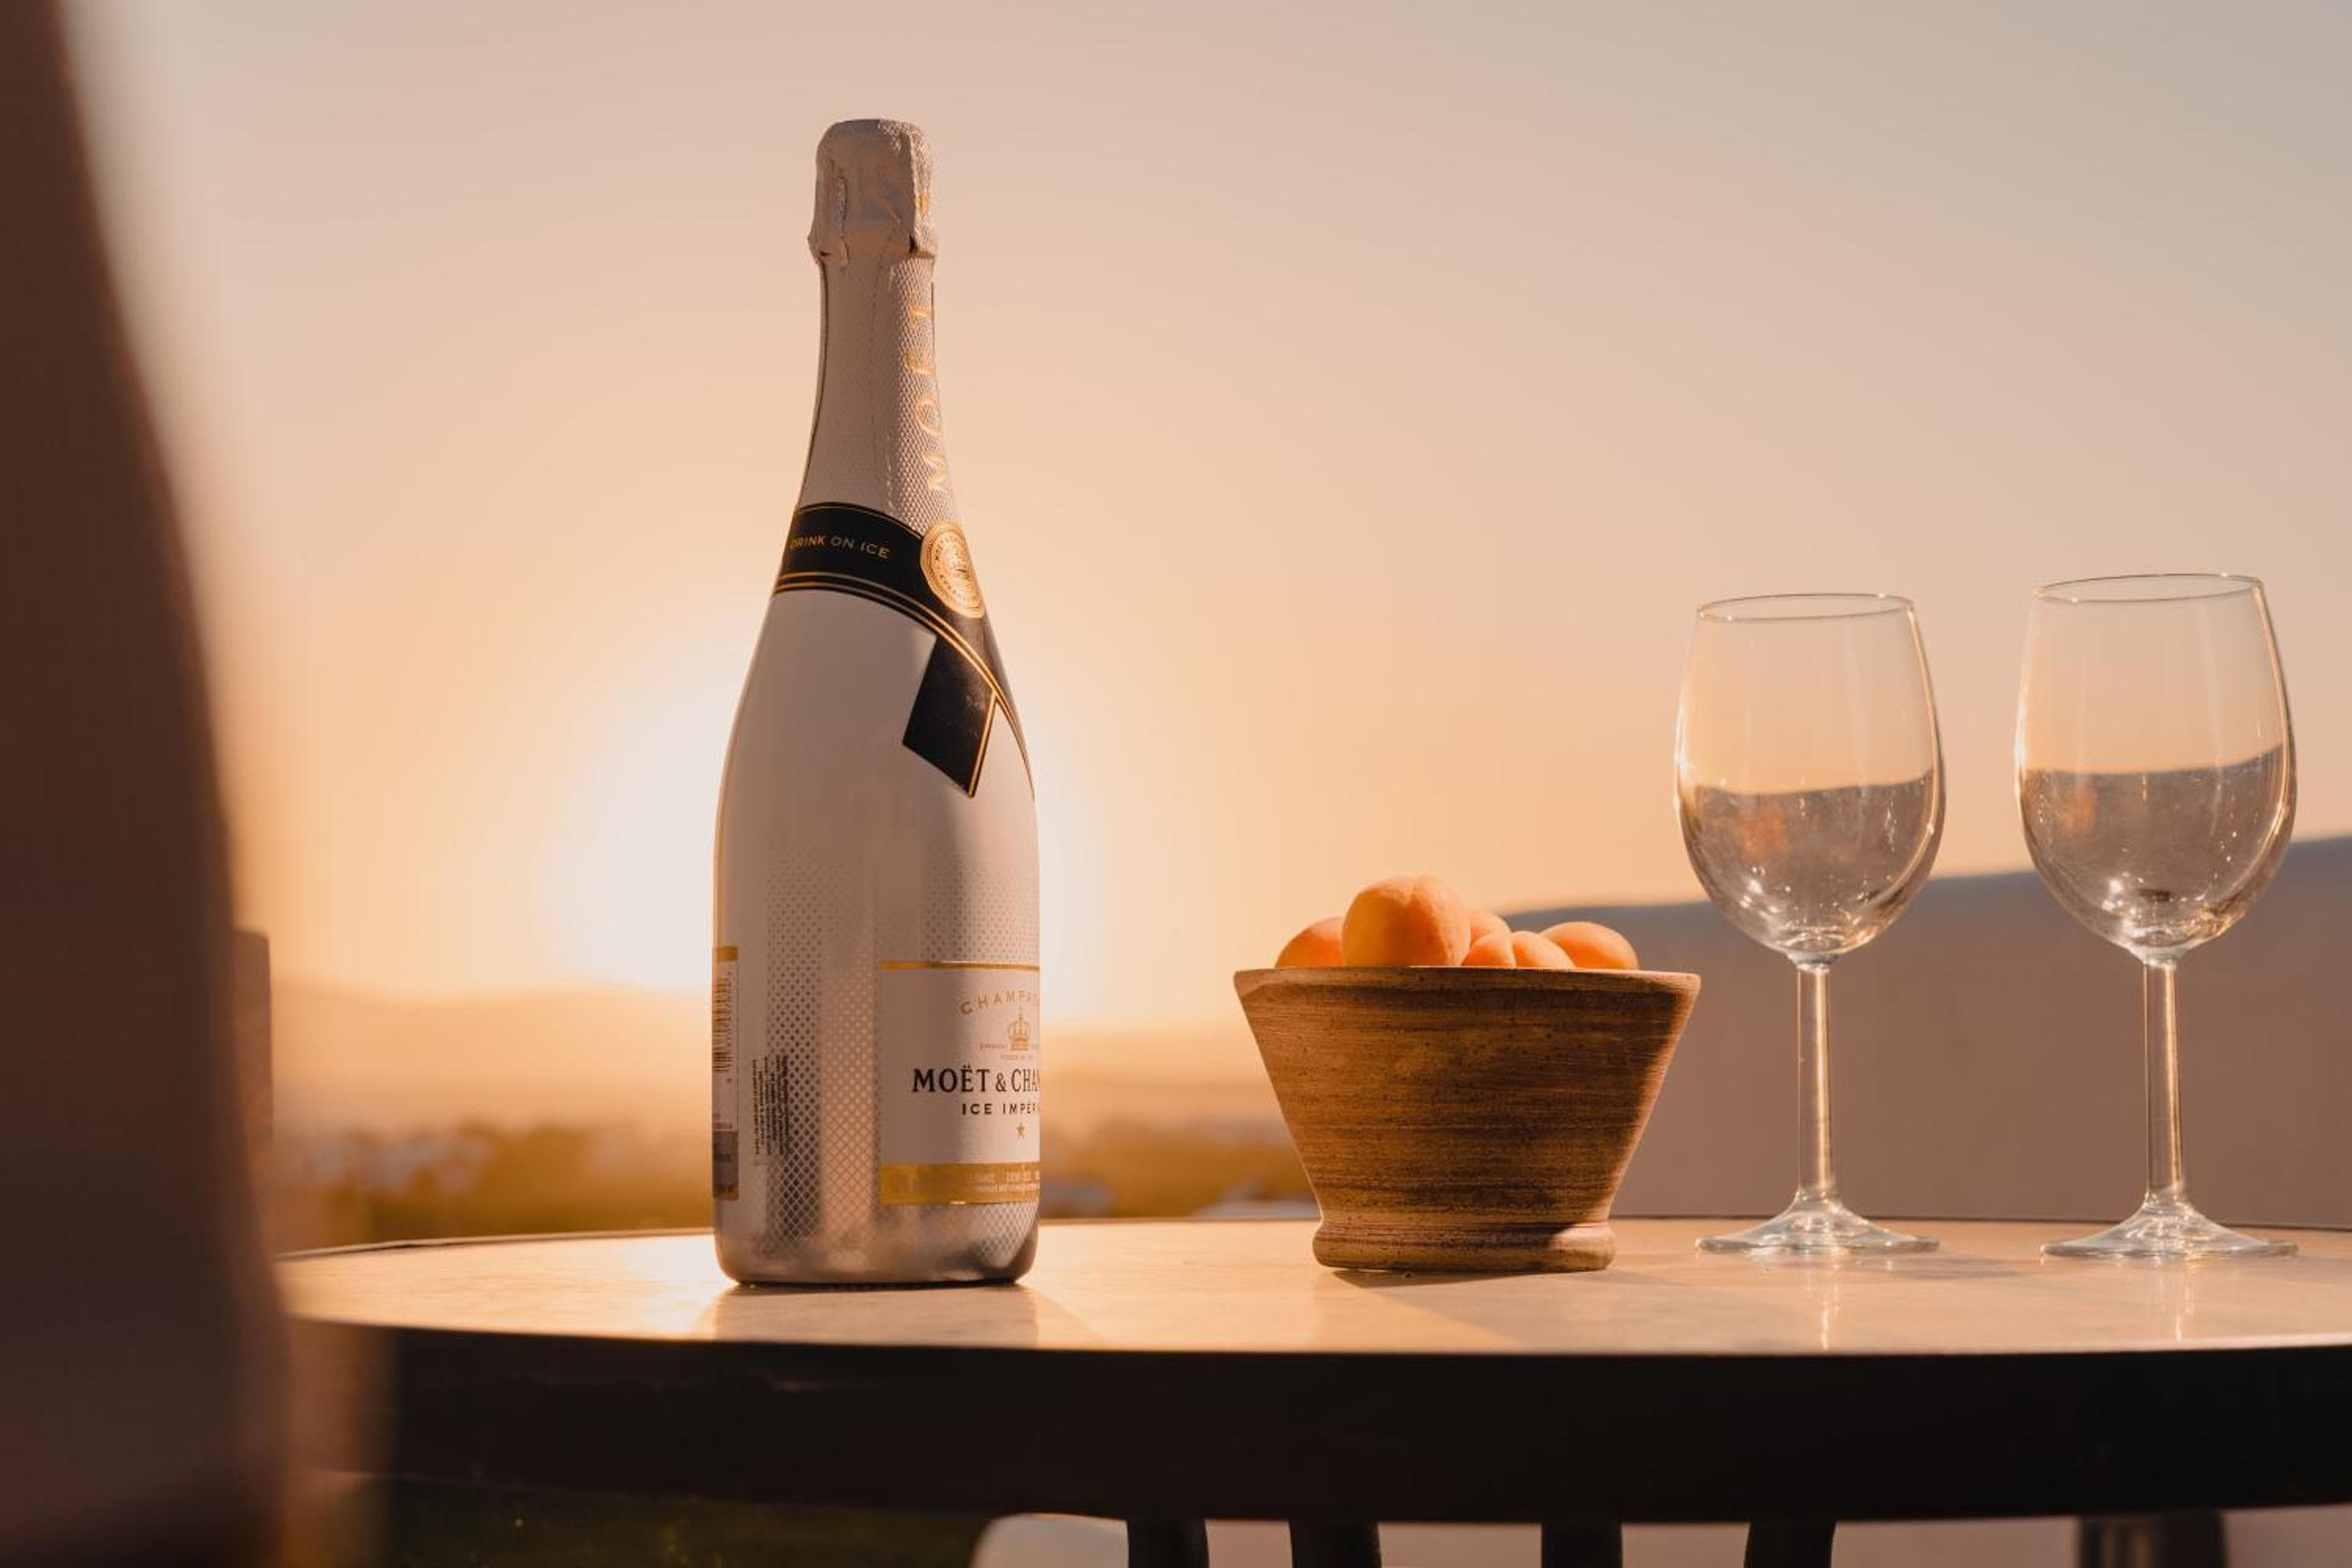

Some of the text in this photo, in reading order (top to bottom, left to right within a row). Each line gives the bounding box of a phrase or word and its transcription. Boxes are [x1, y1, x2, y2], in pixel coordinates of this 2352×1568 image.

[789, 535, 891, 559] DRINK ON ICE
[912, 1064, 989, 1093] MOËT
[995, 1072, 1007, 1092] &
[962, 1103, 993, 1115] ICE
